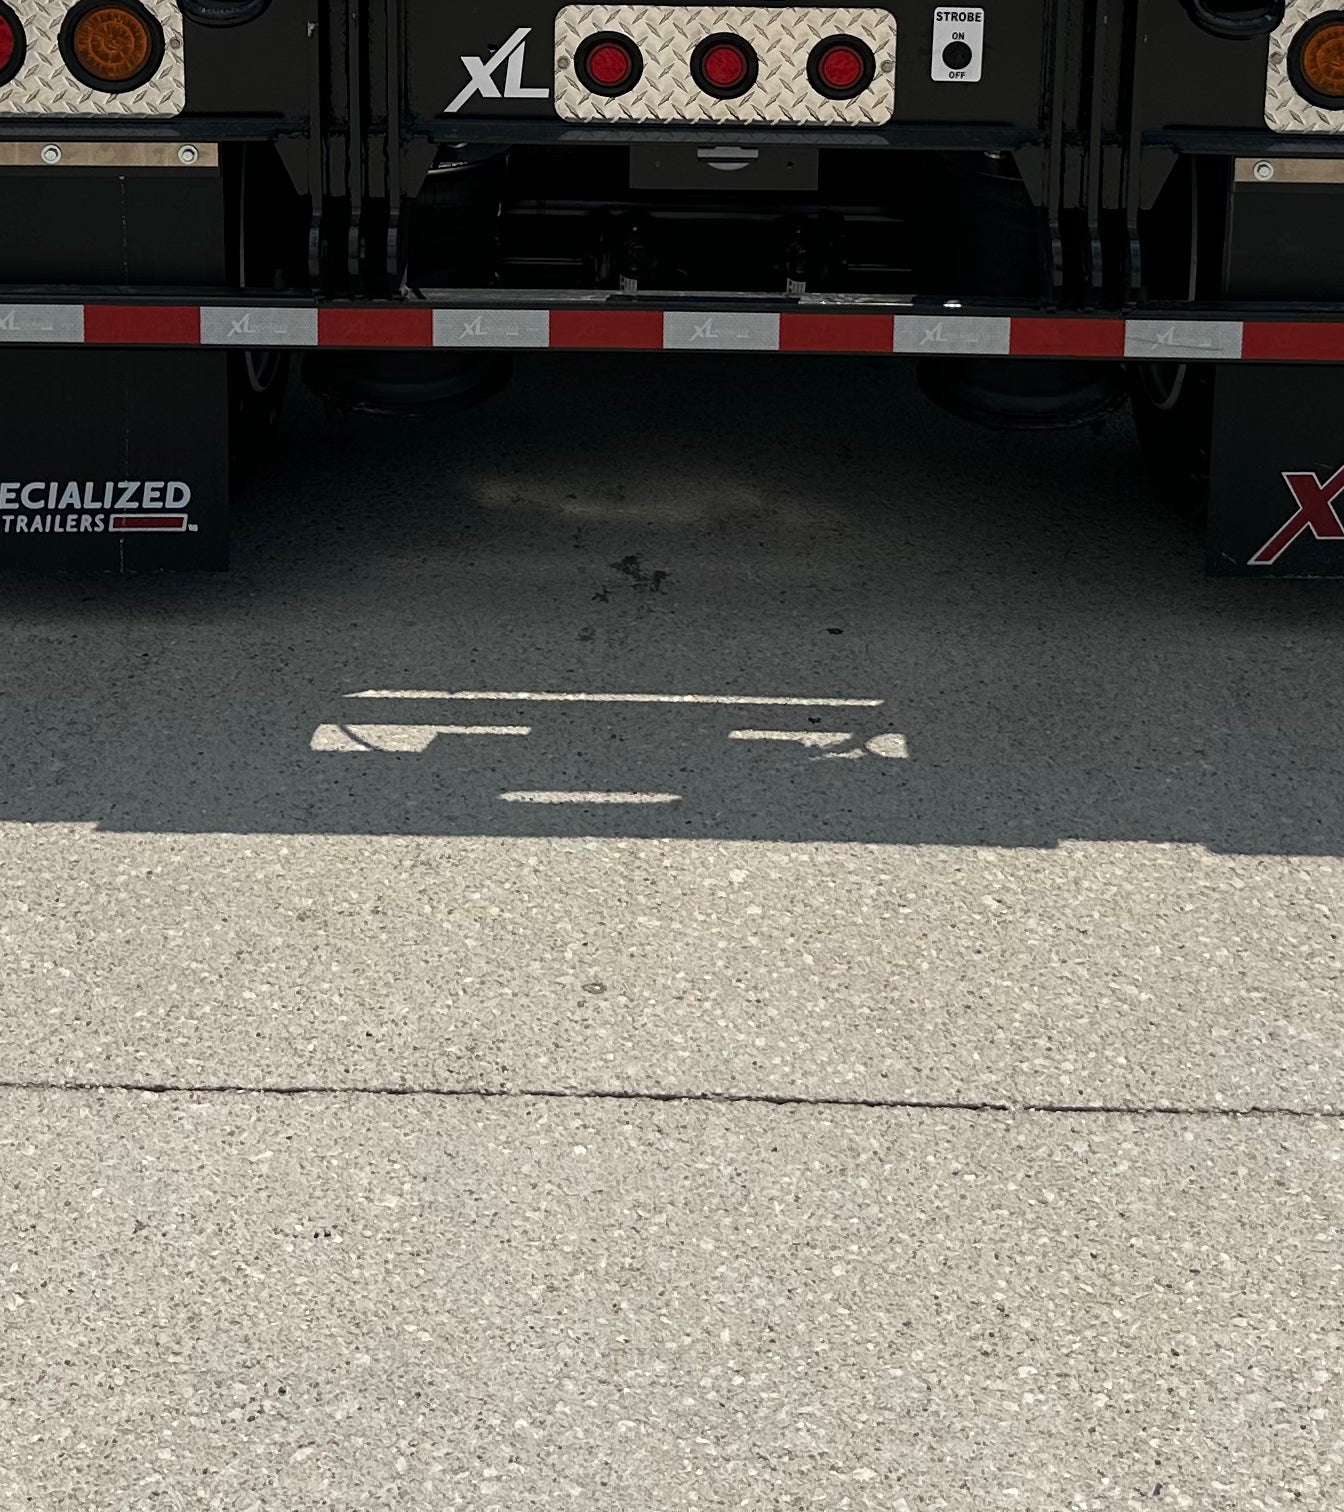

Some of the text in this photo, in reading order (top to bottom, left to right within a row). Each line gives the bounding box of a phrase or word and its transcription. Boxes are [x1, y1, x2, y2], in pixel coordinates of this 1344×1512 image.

[936, 11, 983, 22] STROBE
[952, 32, 965, 40] ON
[443, 28, 550, 113] XL
[948, 71, 966, 79] OFF
[2, 514, 105, 533] TRAILERS
